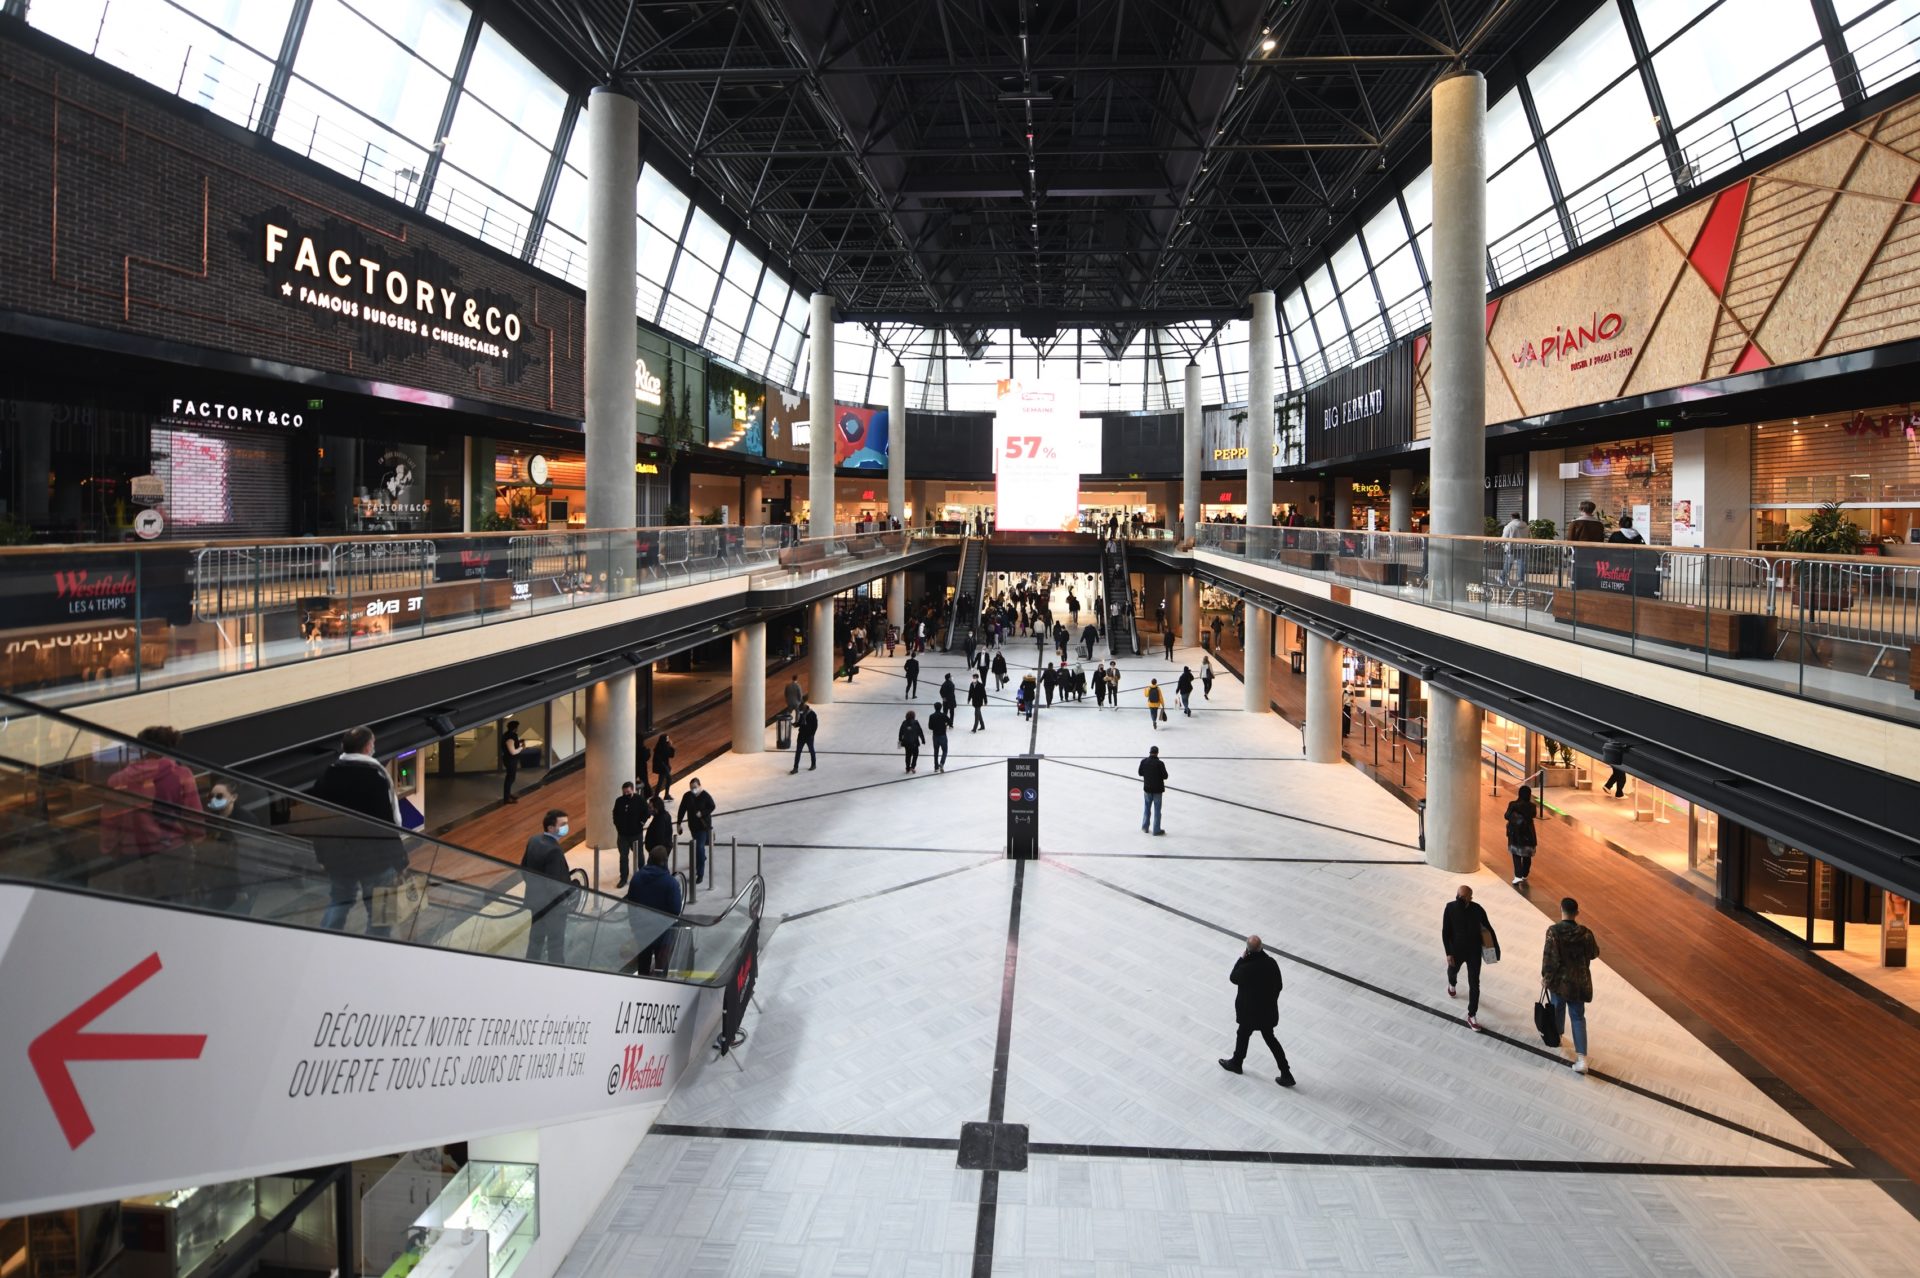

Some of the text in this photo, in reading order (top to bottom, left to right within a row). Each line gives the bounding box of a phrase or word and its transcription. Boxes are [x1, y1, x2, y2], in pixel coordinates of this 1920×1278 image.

[265, 223, 522, 342] FACTORY&CO
[300, 286, 500, 358] FAMOUS BURGERS & CHEESECAKES
[172, 398, 304, 428] FACTORY&CO
[1324, 389, 1382, 430] BIG FERNAND
[54, 569, 137, 598] Westfield
[1596, 560, 1632, 581] Westfield
[1612, 582, 1625, 591] TEMPS
[69, 597, 126, 613] LES 4 TEMPS
[314, 1004, 591, 1047] DÉCOUVREZ NOTRE TERRASSE ÉPHÉMÈRE
[615, 1001, 680, 1034] LA TERRASSE
[288, 1058, 384, 1098] OUVERTE
[386, 1057, 430, 1091] TOUS
[431, 1056, 460, 1087] LES
[461, 1055, 507, 1085] JOURS
[507, 1054, 525, 1081] DE
[526, 1053, 557, 1080] 11H30
[557, 1047, 566, 1077] À
